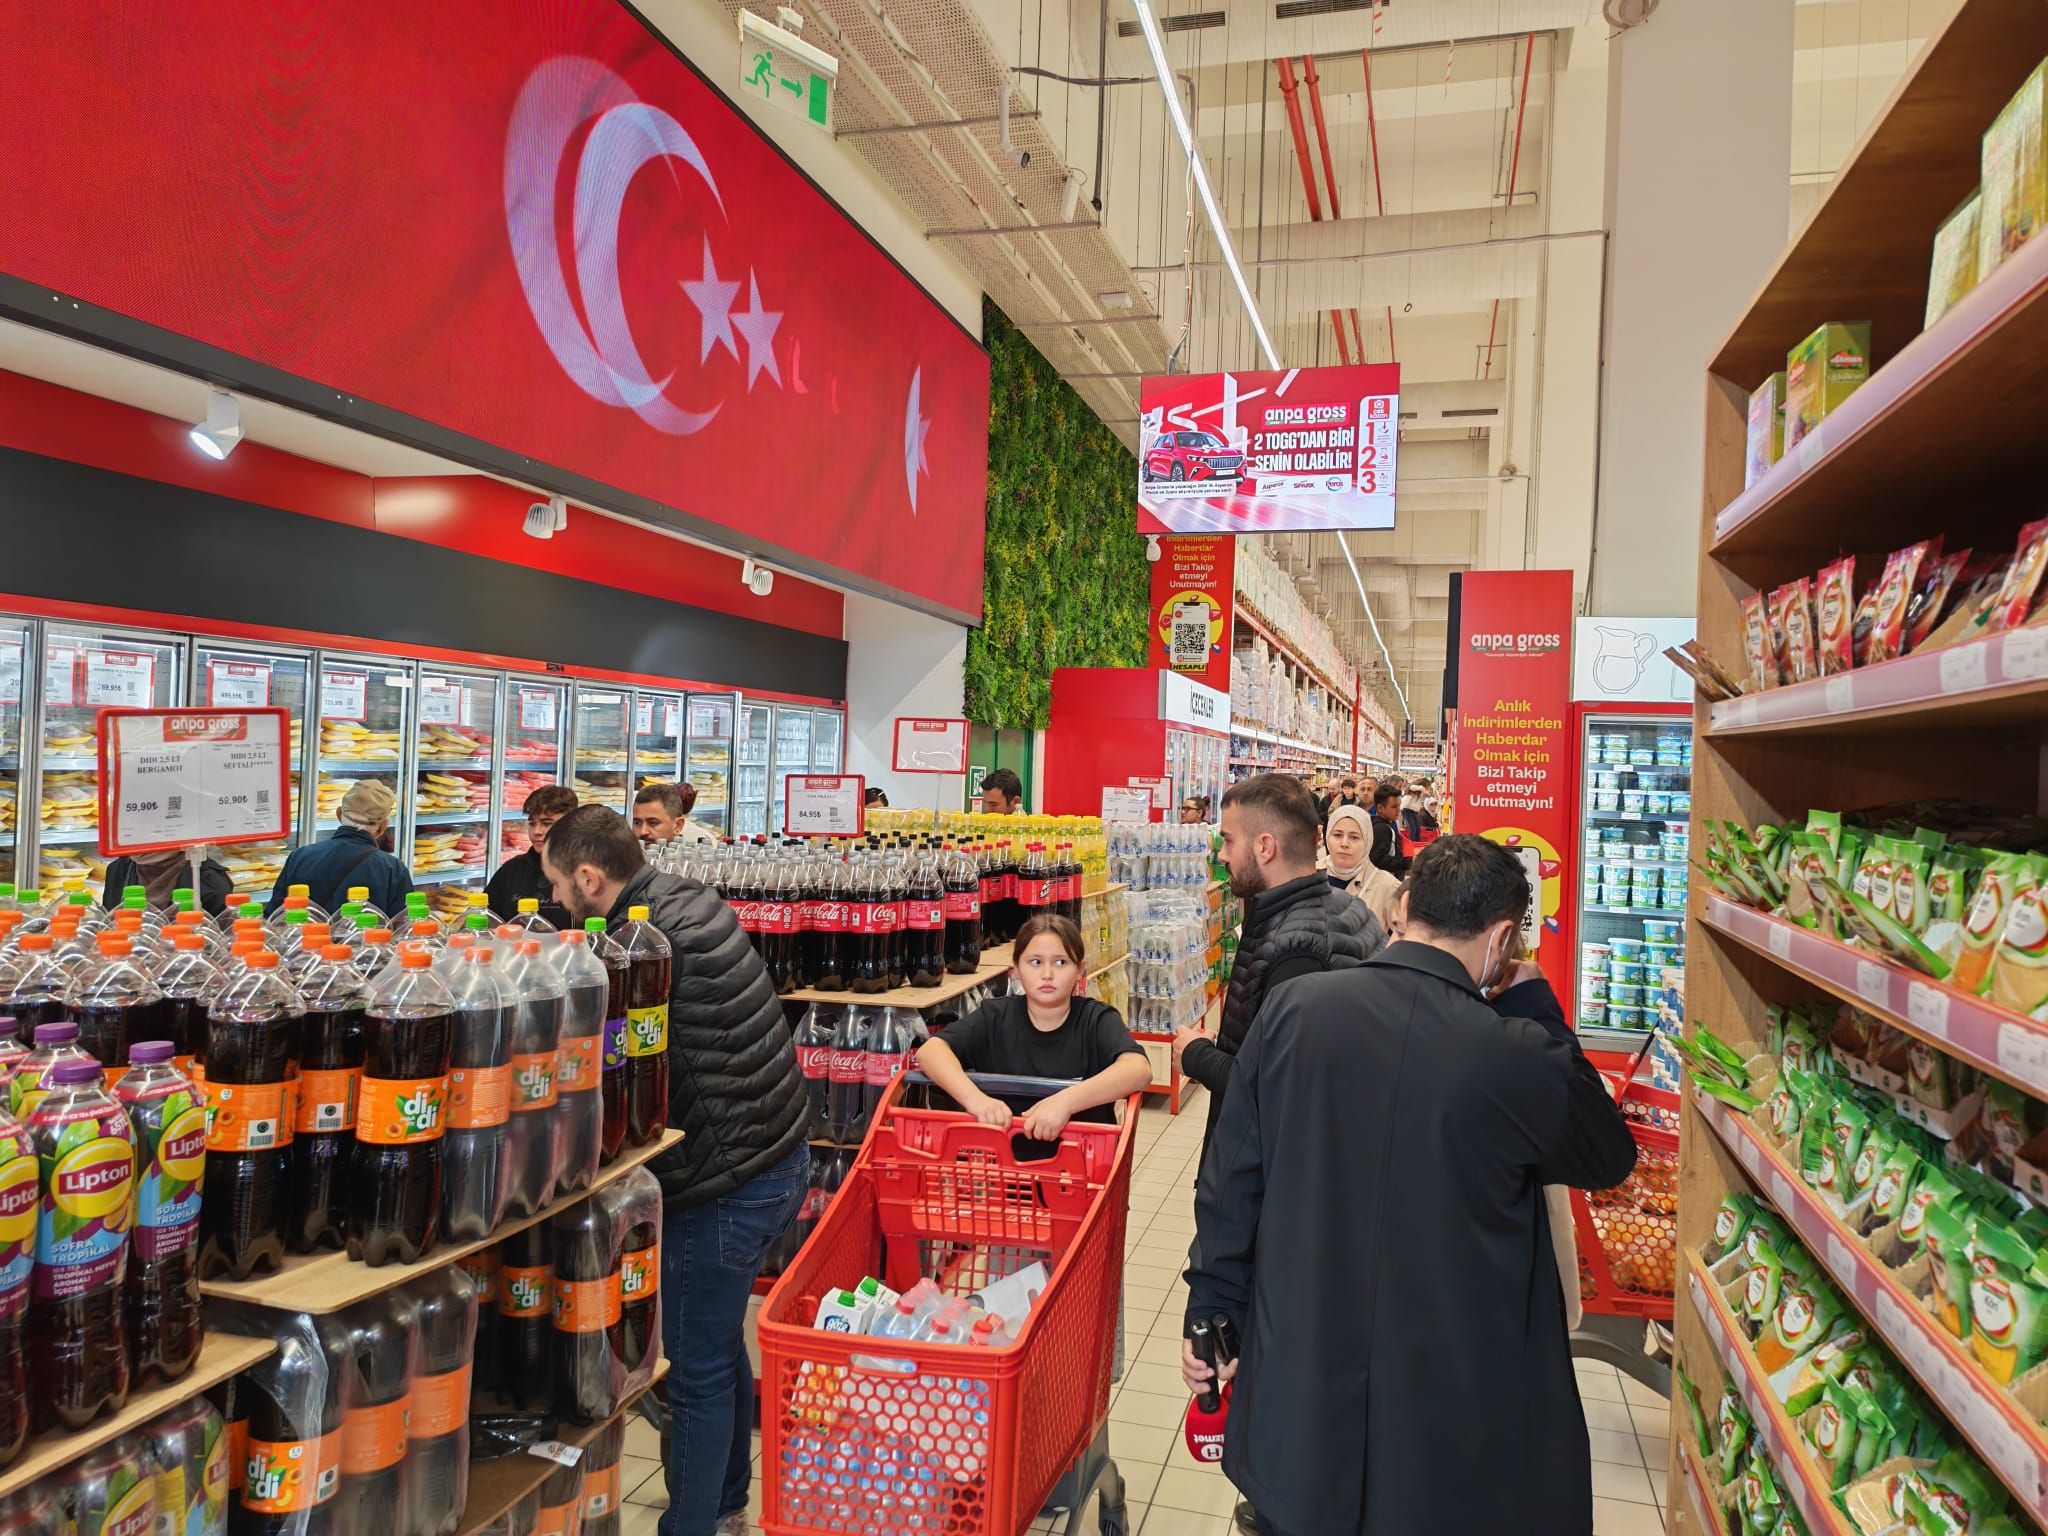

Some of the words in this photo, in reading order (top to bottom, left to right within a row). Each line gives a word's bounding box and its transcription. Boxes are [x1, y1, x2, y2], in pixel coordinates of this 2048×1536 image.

[1265, 408, 1304, 424] anpa
[1307, 405, 1347, 424] gross
[1254, 433, 1263, 451] 2
[1265, 430, 1327, 450] TOGG'DAN
[1329, 426, 1355, 447] BİRİ
[1366, 421, 1375, 445] 1
[1255, 452, 1292, 472] SENİN
[1294, 449, 1353, 471] OLABİLİR!
[1360, 446, 1376, 469] 2
[1361, 470, 1376, 494] 3
[1201, 554, 1216, 562] için
[1192, 563, 1214, 573] Takip
[1170, 581, 1217, 589] Unutmayın!
[1179, 573, 1208, 581] etmeyi
[1471, 634, 1513, 650] anpa
[1517, 634, 1560, 651] gross
[1172, 663, 1205, 671] HESAPLI
[1494, 700, 1532, 712] Anlık
[172, 717, 205, 733] anpa
[207, 717, 240, 733] gross
[1463, 713, 1562, 729] İndirimlerden
[1476, 733, 1547, 746] Haberdar
[140, 756, 158, 764] DIDI
[171, 755, 181, 763] LT
[1473, 749, 1521, 762] Olmak
[1524, 749, 1550, 765] için
[137, 764, 184, 774] BERGAMOT
[1477, 766, 1504, 778] Bizi
[1507, 766, 1547, 782] Takip
[1486, 783, 1537, 795] etmeyi
[125, 800, 159, 812] 59,90₺
[1470, 795, 1554, 811] Unutmayın!
[171, 1134, 206, 1156] Lipto
[66, 1163, 129, 1191] Lipton
[0, 1184, 39, 1213] ipto
[156, 1201, 188, 1216] SOFRA
[51, 1239, 94, 1254] SOFRA
[51, 1243, 112, 1264] TROPİKAL
